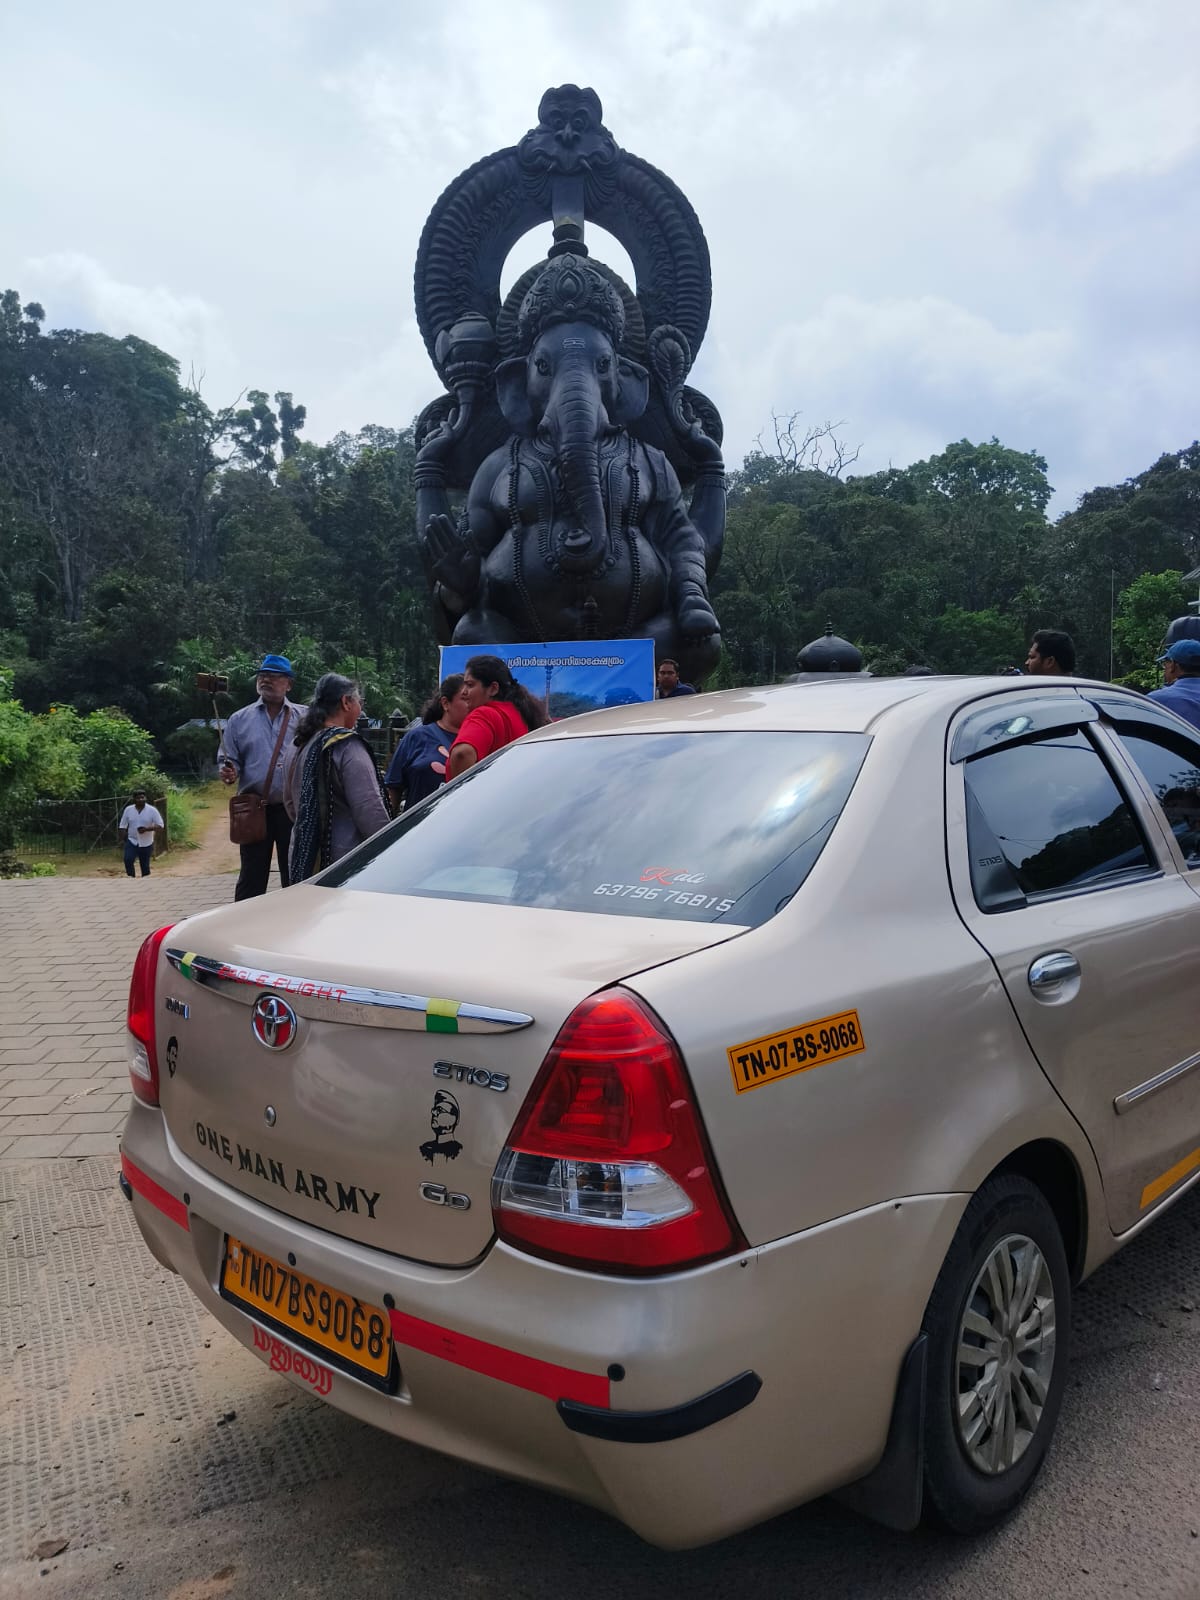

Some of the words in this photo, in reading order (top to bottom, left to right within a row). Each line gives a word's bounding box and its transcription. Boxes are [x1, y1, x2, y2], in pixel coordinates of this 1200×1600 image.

[593, 884, 662, 900] 63796
[664, 890, 736, 912] 76815
[640, 867, 705, 885] Kali
[217, 965, 268, 986] EAGLE
[271, 977, 347, 1003] FLIGHT
[737, 1020, 859, 1081] TN-07-BS-9068
[433, 1060, 510, 1091] ETIOS
[195, 1121, 233, 1165] ONE
[236, 1143, 291, 1194] MAN
[294, 1168, 381, 1220] ARMY
[240, 1247, 384, 1358] TN07BS9068
[252, 1324, 334, 1395] மதுரை
